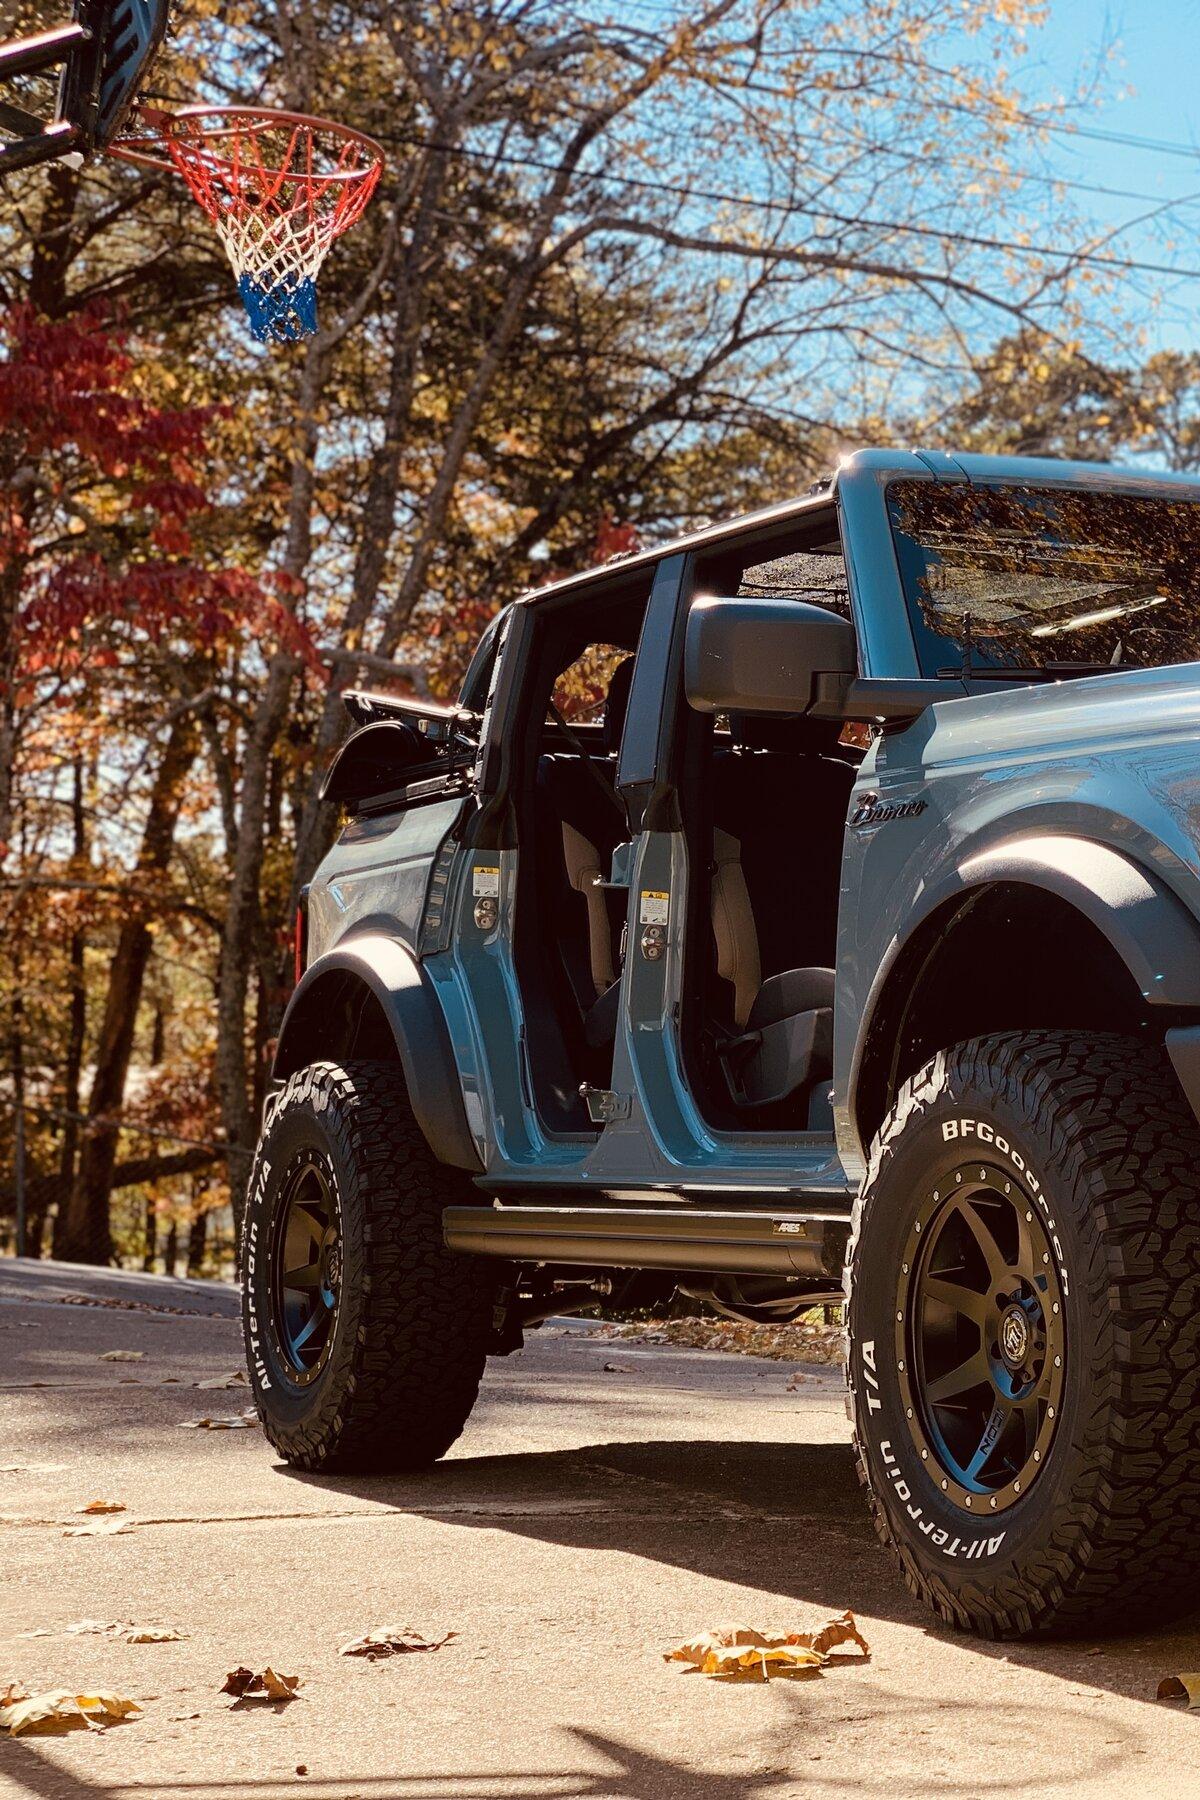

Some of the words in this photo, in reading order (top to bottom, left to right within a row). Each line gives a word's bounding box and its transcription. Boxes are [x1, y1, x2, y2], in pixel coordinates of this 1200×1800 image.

[254, 1160, 272, 1204] T/A
[942, 1119, 1069, 1296] BFGoodrich
[248, 1222, 272, 1390] All-Terrain
[862, 1340, 882, 1416] T/A
[881, 1440, 1007, 1559] All-Terrain
